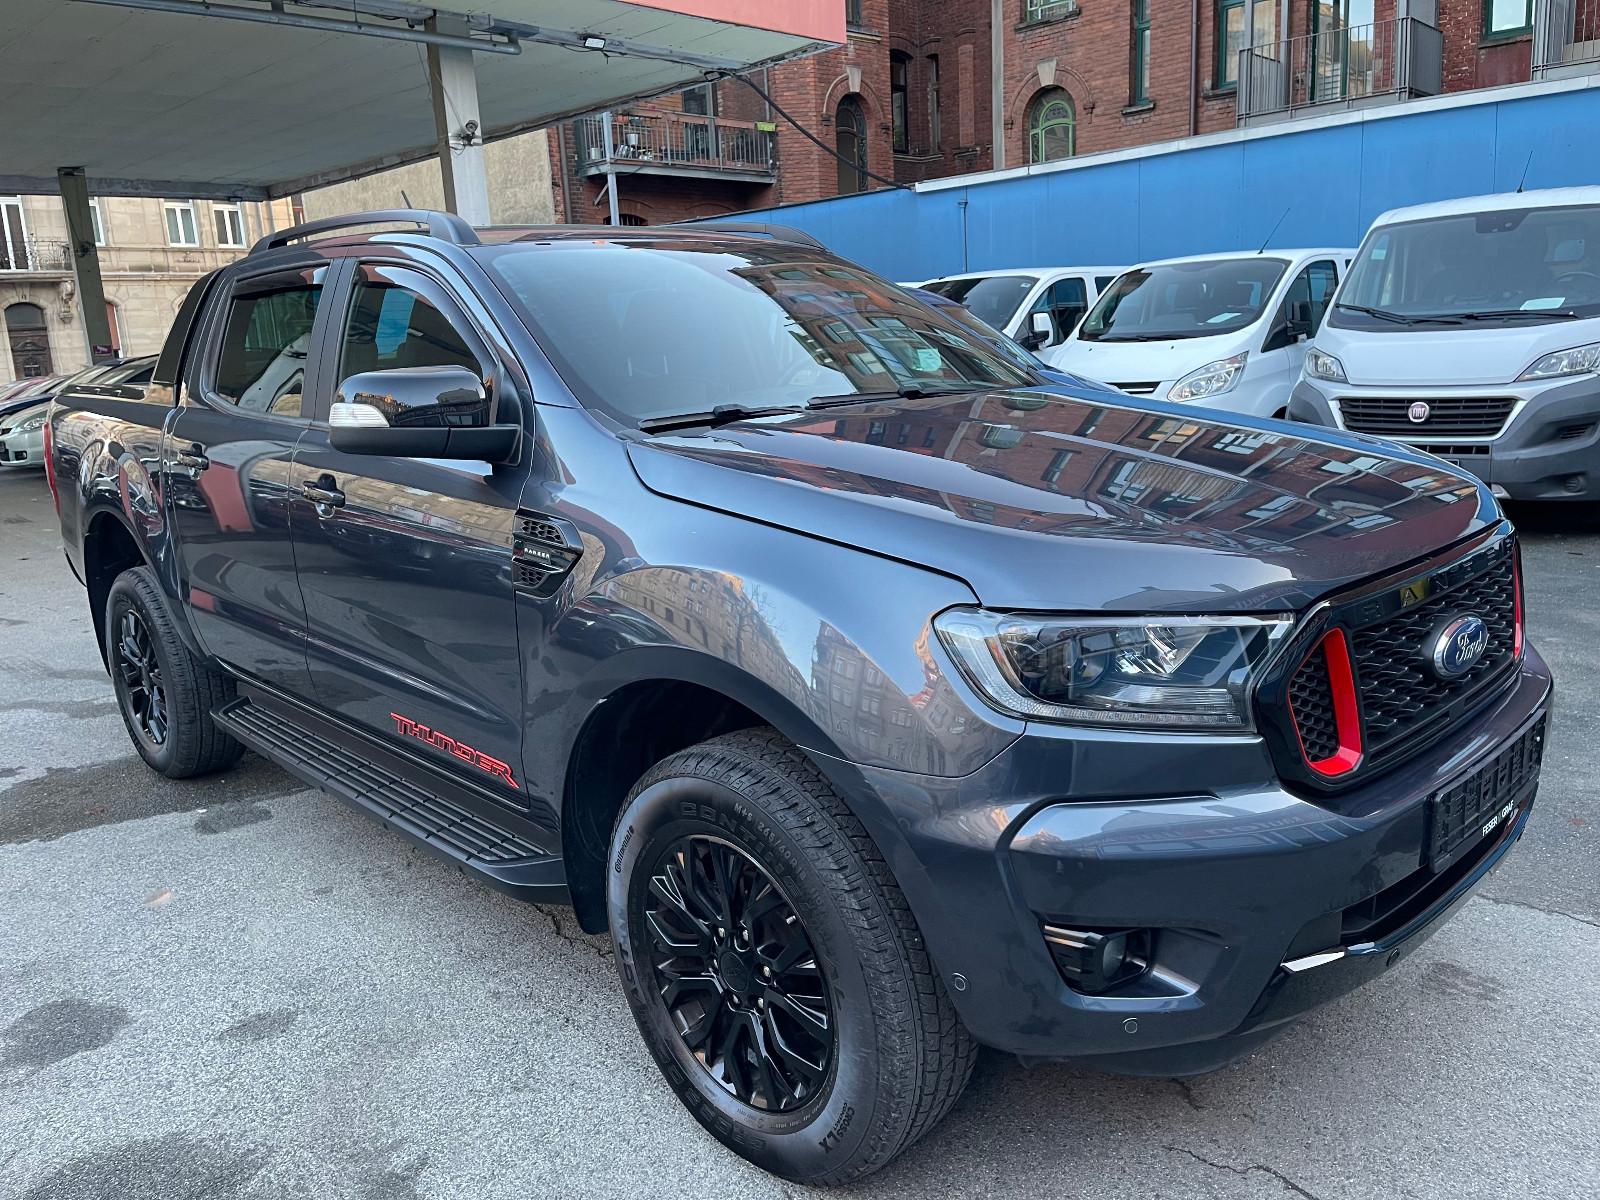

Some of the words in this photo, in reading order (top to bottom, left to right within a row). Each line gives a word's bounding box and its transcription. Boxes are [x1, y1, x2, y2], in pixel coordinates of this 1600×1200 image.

[1412, 407, 1426, 418] FIAT
[1456, 627, 1484, 664] Ford
[389, 711, 520, 789] THUNDER
[1482, 815, 1498, 837] FESER
[1501, 799, 1514, 818] GRAF
[836, 1106, 855, 1138] CROSS
[818, 1130, 841, 1154] LX
